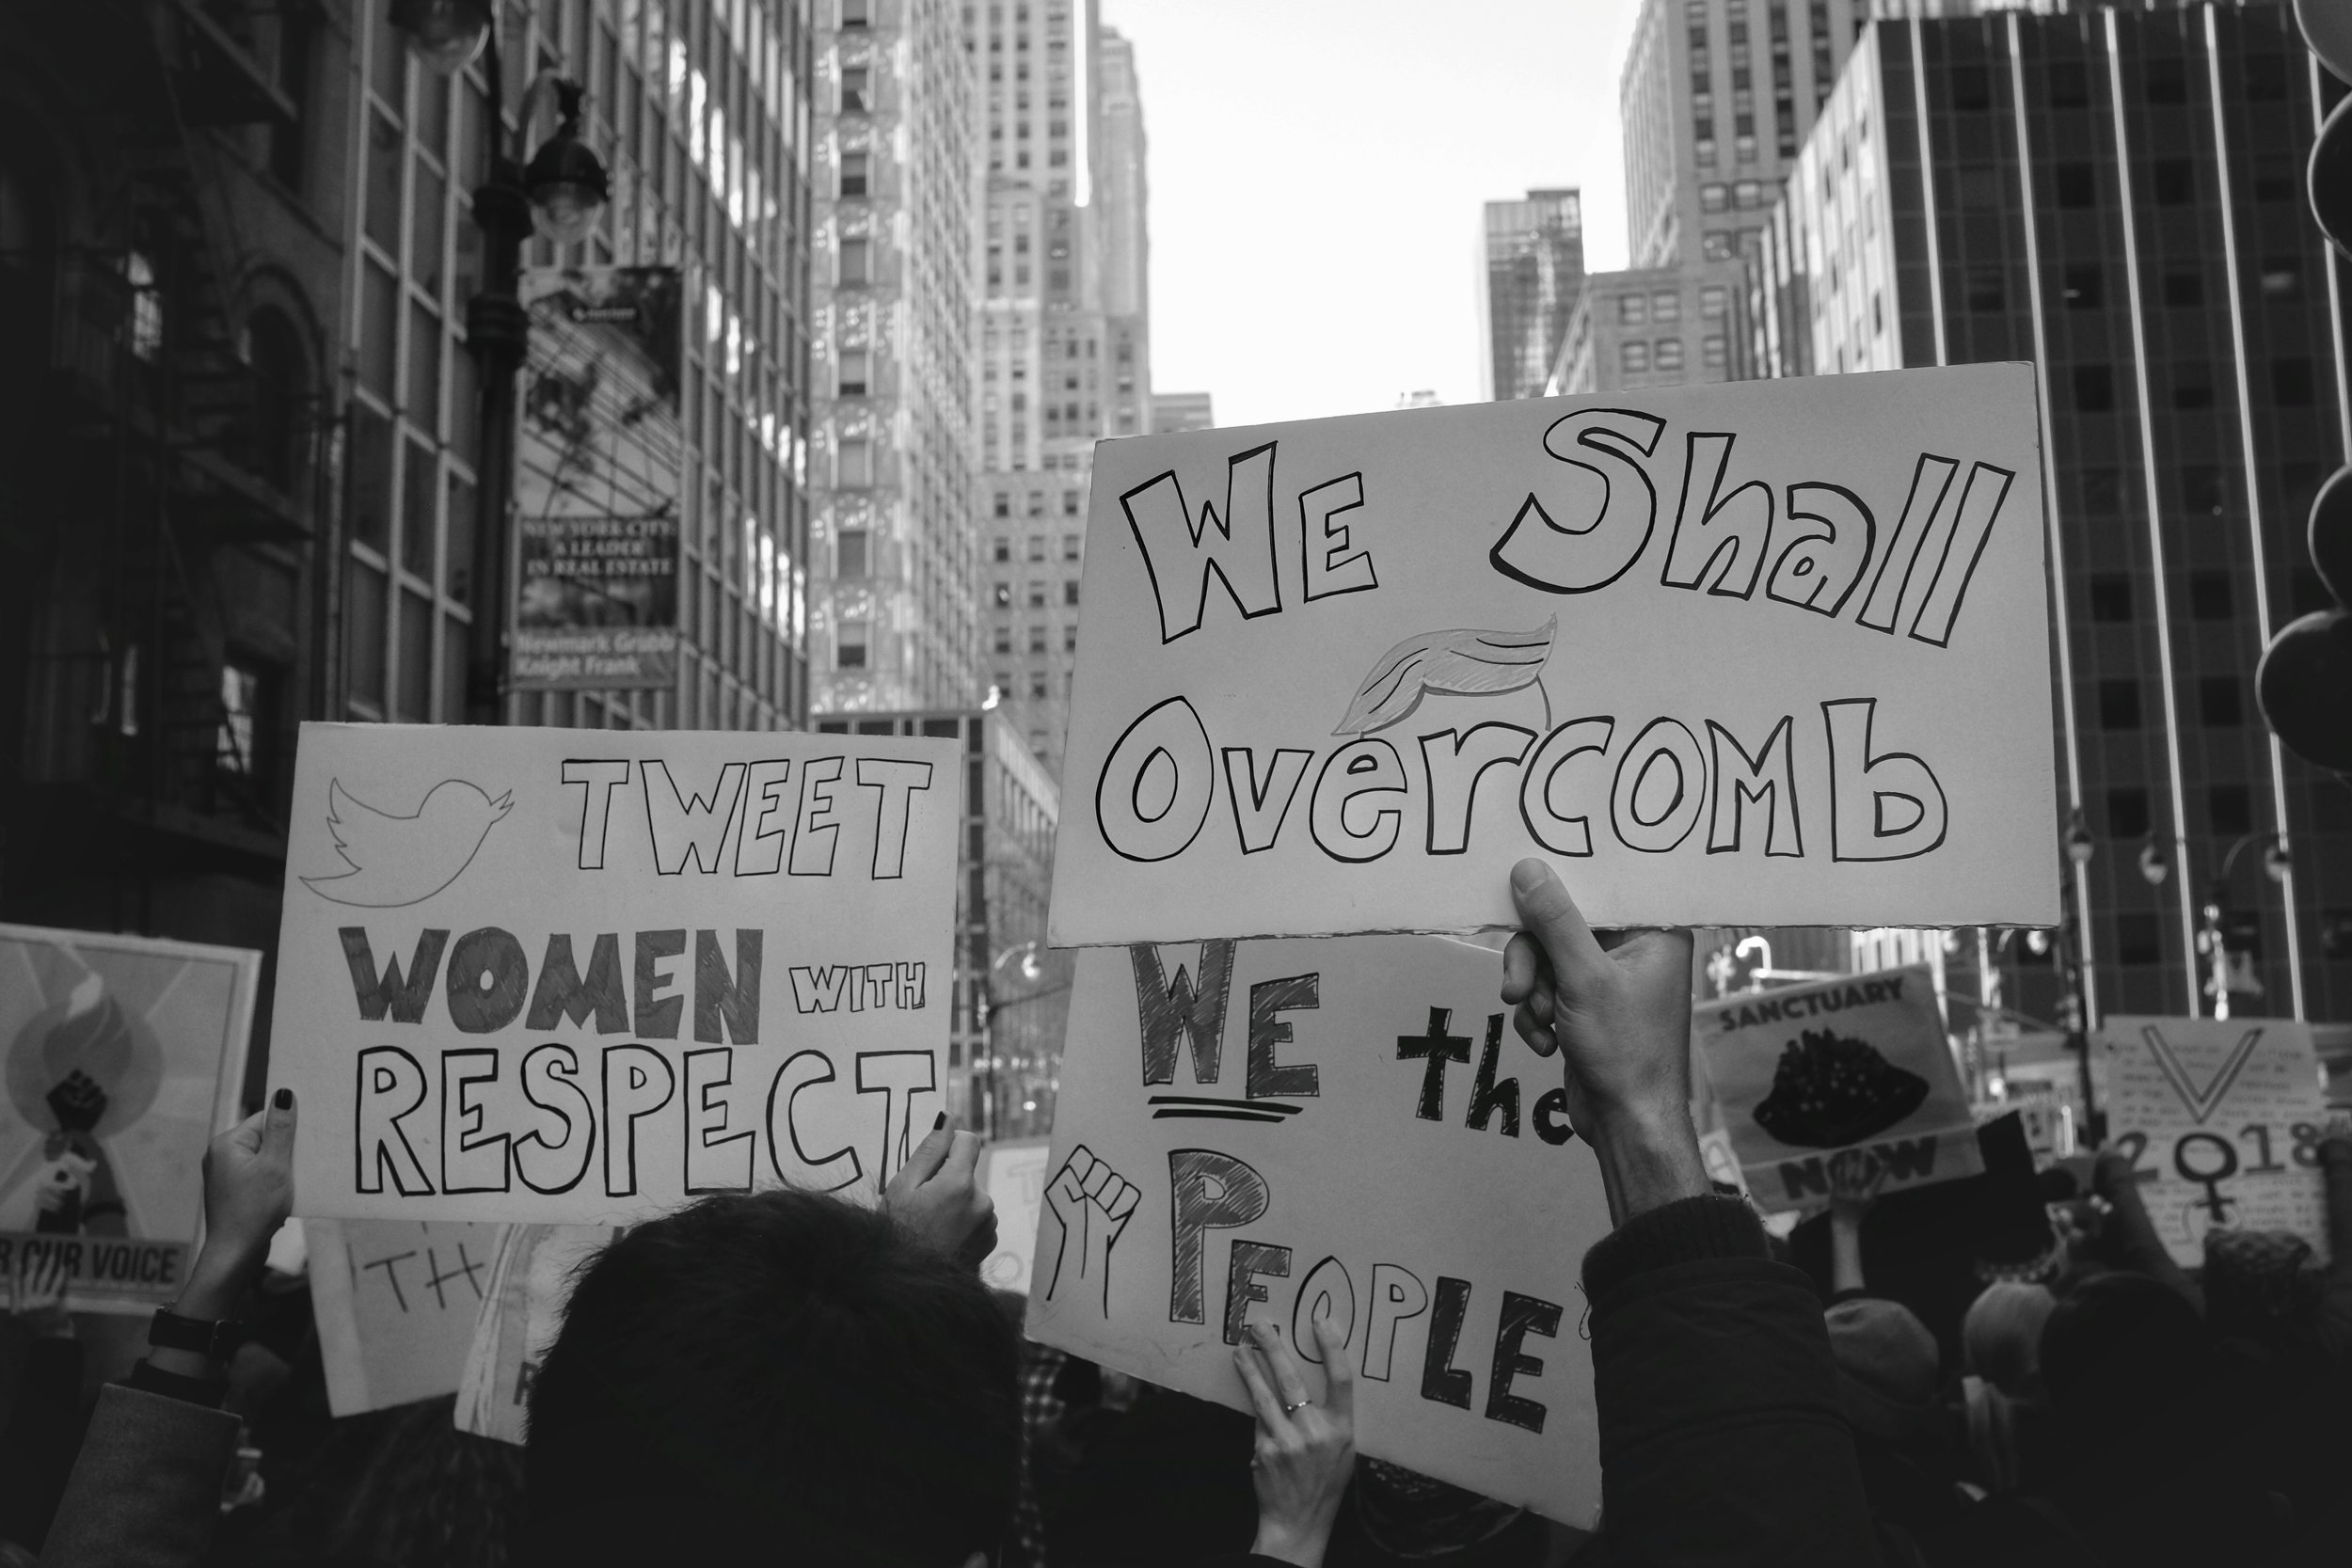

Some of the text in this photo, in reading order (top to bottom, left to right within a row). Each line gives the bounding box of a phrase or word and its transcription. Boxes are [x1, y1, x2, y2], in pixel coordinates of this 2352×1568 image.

[605, 559, 673, 576] ESTATE
[1120, 408, 2017, 649] WE Shall
[562, 757, 934, 879] TWEET
[338, 927, 927, 1045] WOMEN WITH
[1130, 941, 1321, 1099] WE
[1718, 974, 1905, 1034] SANCTUARY
[356, 1044, 937, 1196] RESPECT
[92, 1243, 178, 1282] VOICE
[1168, 1148, 1564, 1433] PEOPLE
